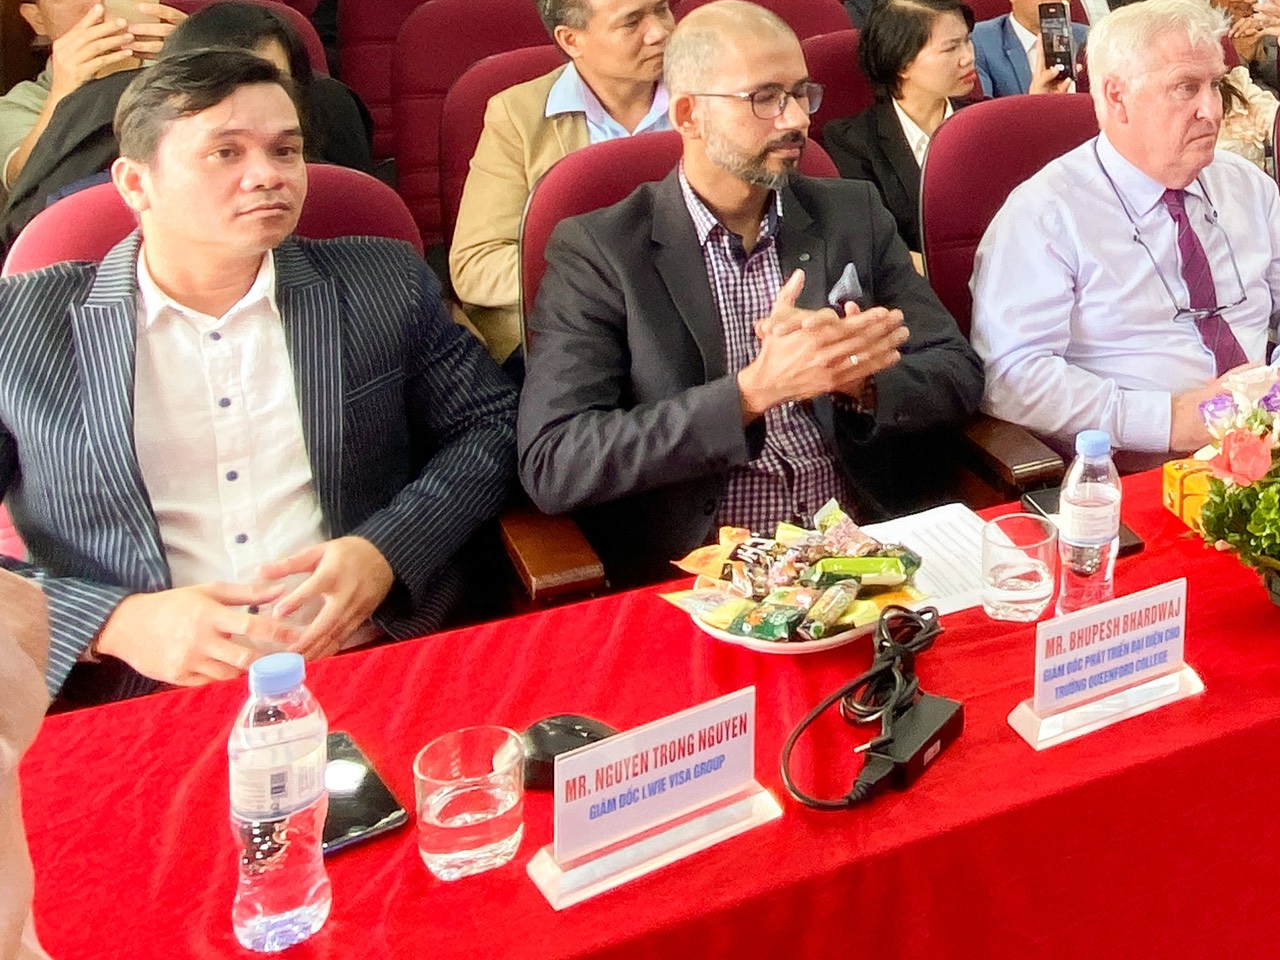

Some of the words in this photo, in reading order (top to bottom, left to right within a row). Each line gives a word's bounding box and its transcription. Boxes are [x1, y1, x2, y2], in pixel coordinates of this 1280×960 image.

[1045, 635, 1066, 659] MR.
[1069, 618, 1121, 651] BHUPESH
[1122, 597, 1182, 633] BHARDWAJ
[565, 775, 591, 803] MR.
[595, 753, 649, 792] NGUYEN
[653, 733, 695, 768] TRONG
[698, 712, 748, 753] NGUYEN
[669, 768, 692, 789] VISA
[693, 754, 726, 779] GROUP
